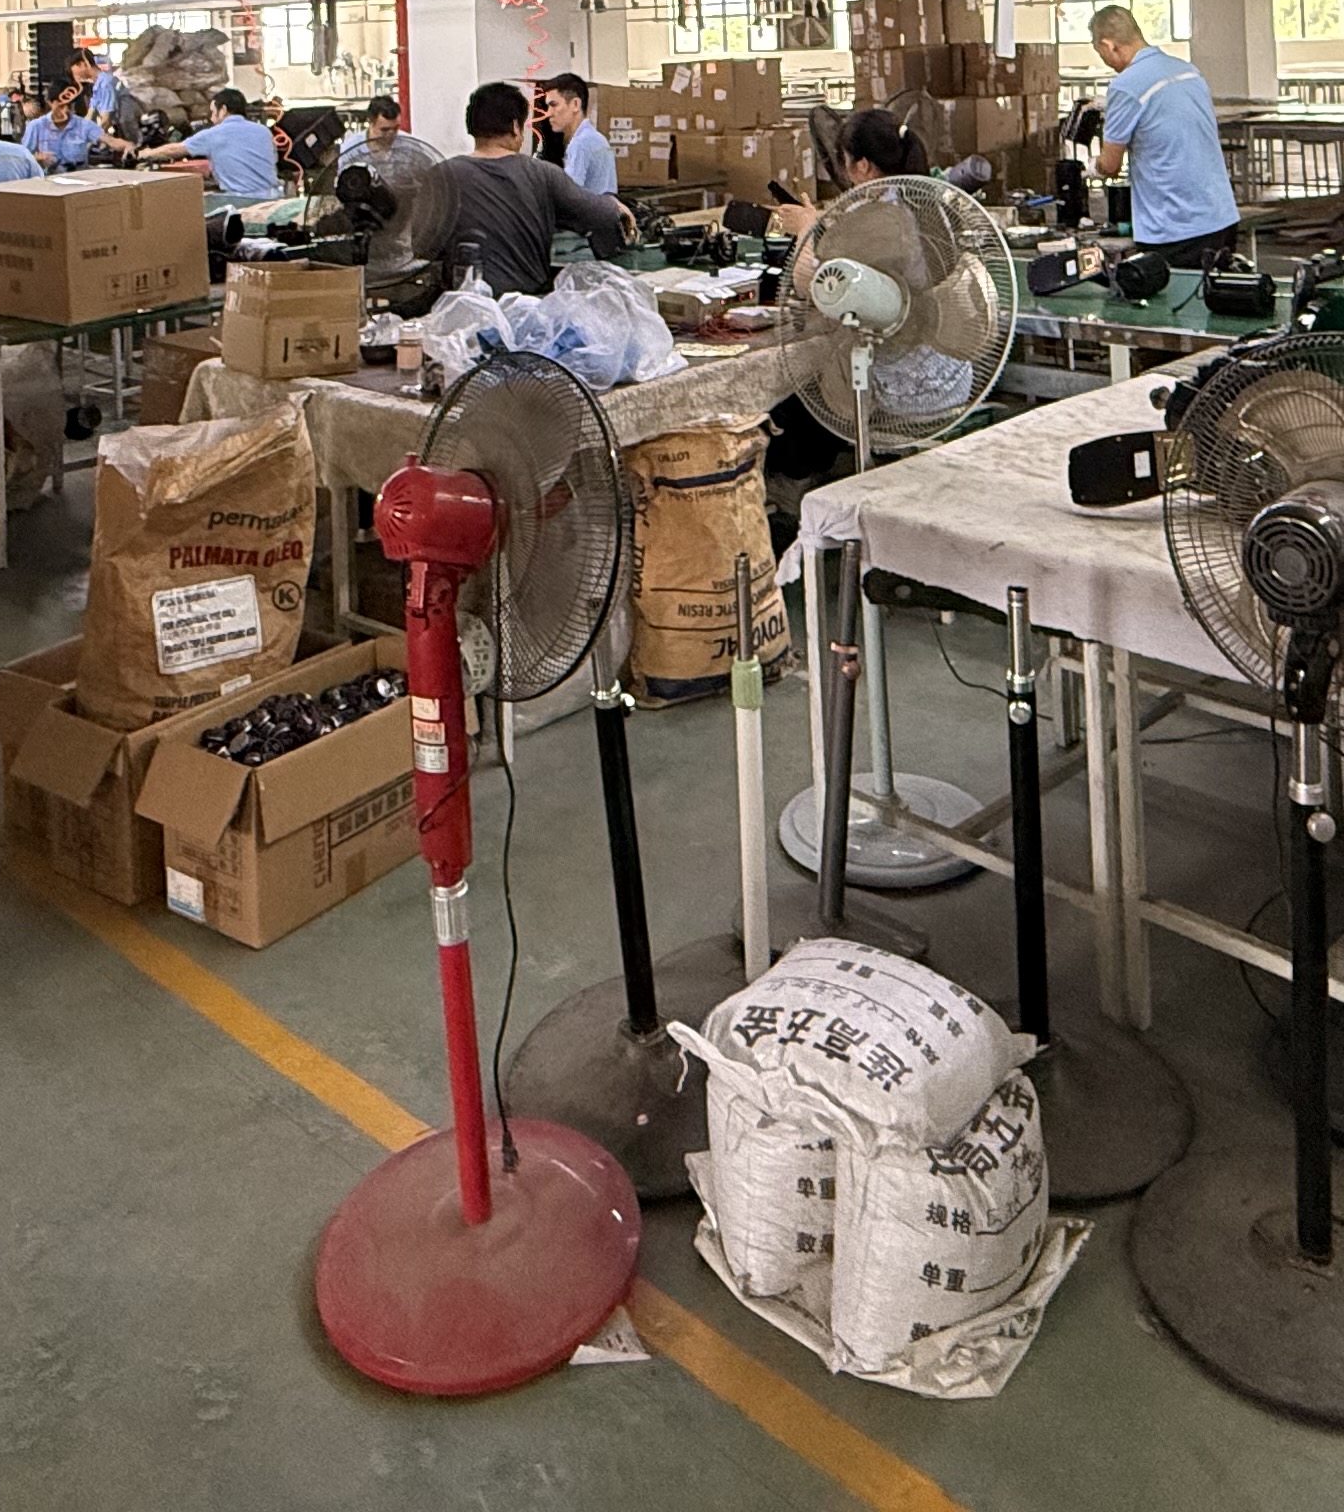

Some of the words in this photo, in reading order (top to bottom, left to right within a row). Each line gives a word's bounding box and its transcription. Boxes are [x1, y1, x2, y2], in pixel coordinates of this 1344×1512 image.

[169, 544, 260, 570] PALMATA
[678, 603, 713, 618] RESIN
[711, 611, 786, 660] TOYOAC
[734, 1005, 913, 1092] 连高五金
[925, 1201, 972, 1236] 规格
[918, 1261, 967, 1293] 单重
